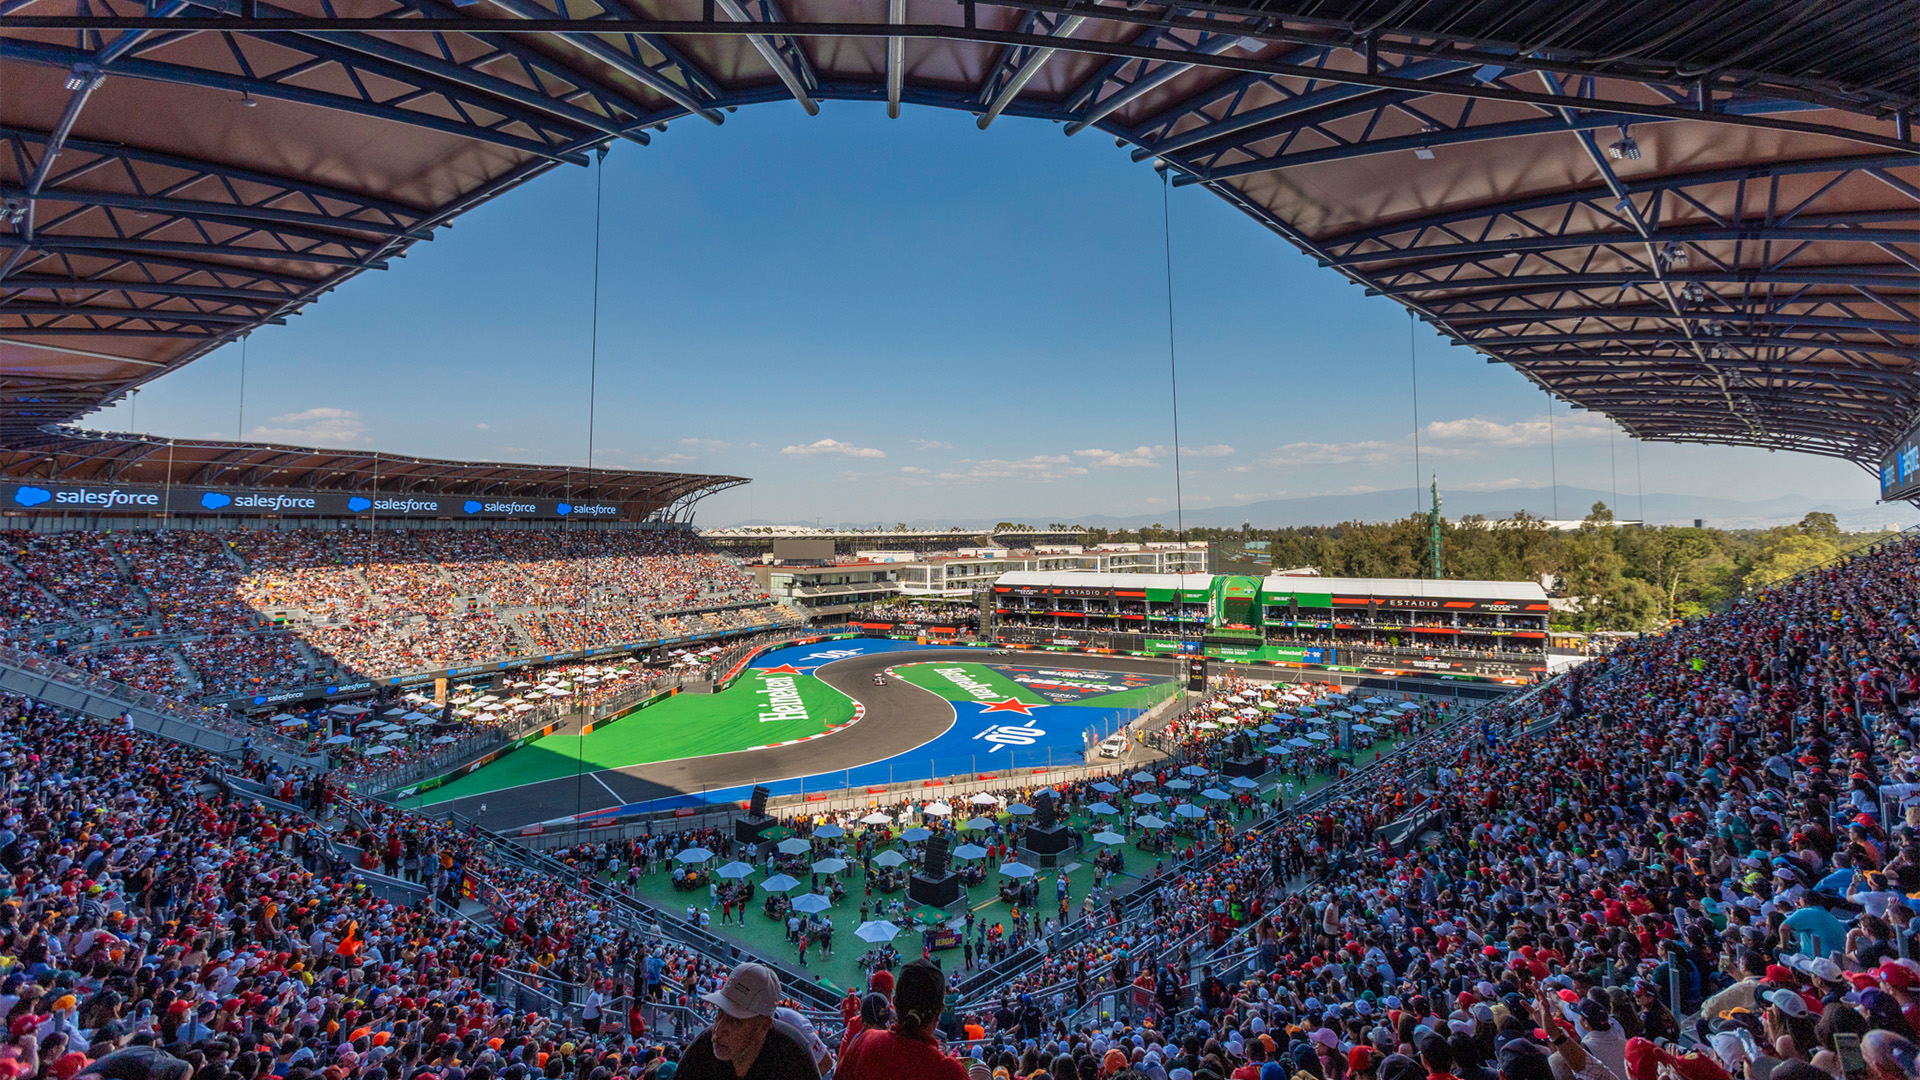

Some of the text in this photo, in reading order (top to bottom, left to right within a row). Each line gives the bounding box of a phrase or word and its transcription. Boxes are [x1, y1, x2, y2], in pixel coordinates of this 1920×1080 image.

[56, 489, 159, 507] salesforce
[234, 494, 315, 511] salesforce
[374, 498, 438, 513] salesforce
[484, 501, 536, 514] salesforce
[574, 503, 616, 515] salesforce
[507, 659, 531, 667] salesforce
[457, 666, 483, 674] salesforce
[401, 673, 430, 682] salesforce
[933, 667, 1001, 700] Heineken
[338, 682, 371, 693] salesforce
[1013, 677, 1129, 691] MEXICO
[1029, 683, 1093, 693] CITY
[267, 691, 304, 702] salesforce
[756, 677, 809, 722] Heineken
